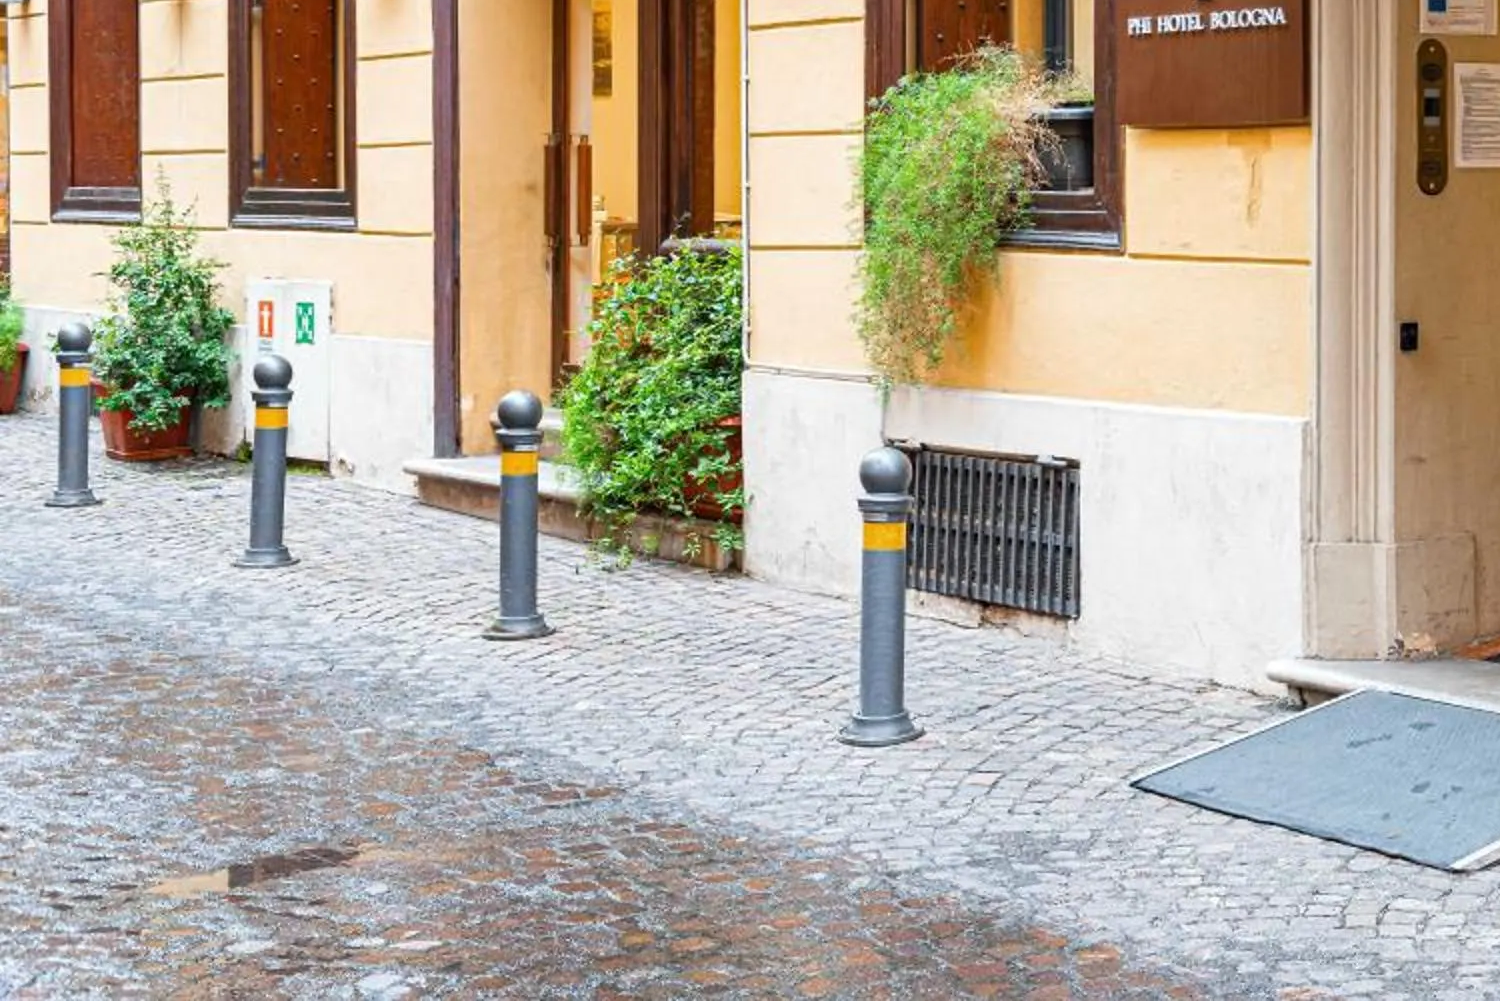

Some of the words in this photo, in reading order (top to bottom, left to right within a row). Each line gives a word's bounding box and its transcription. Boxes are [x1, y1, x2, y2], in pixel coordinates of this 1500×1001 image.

[1127, 15, 1152, 36] PHI
[1157, 12, 1206, 33] HOTEL
[1209, 6, 1288, 30] BOLOGNA
